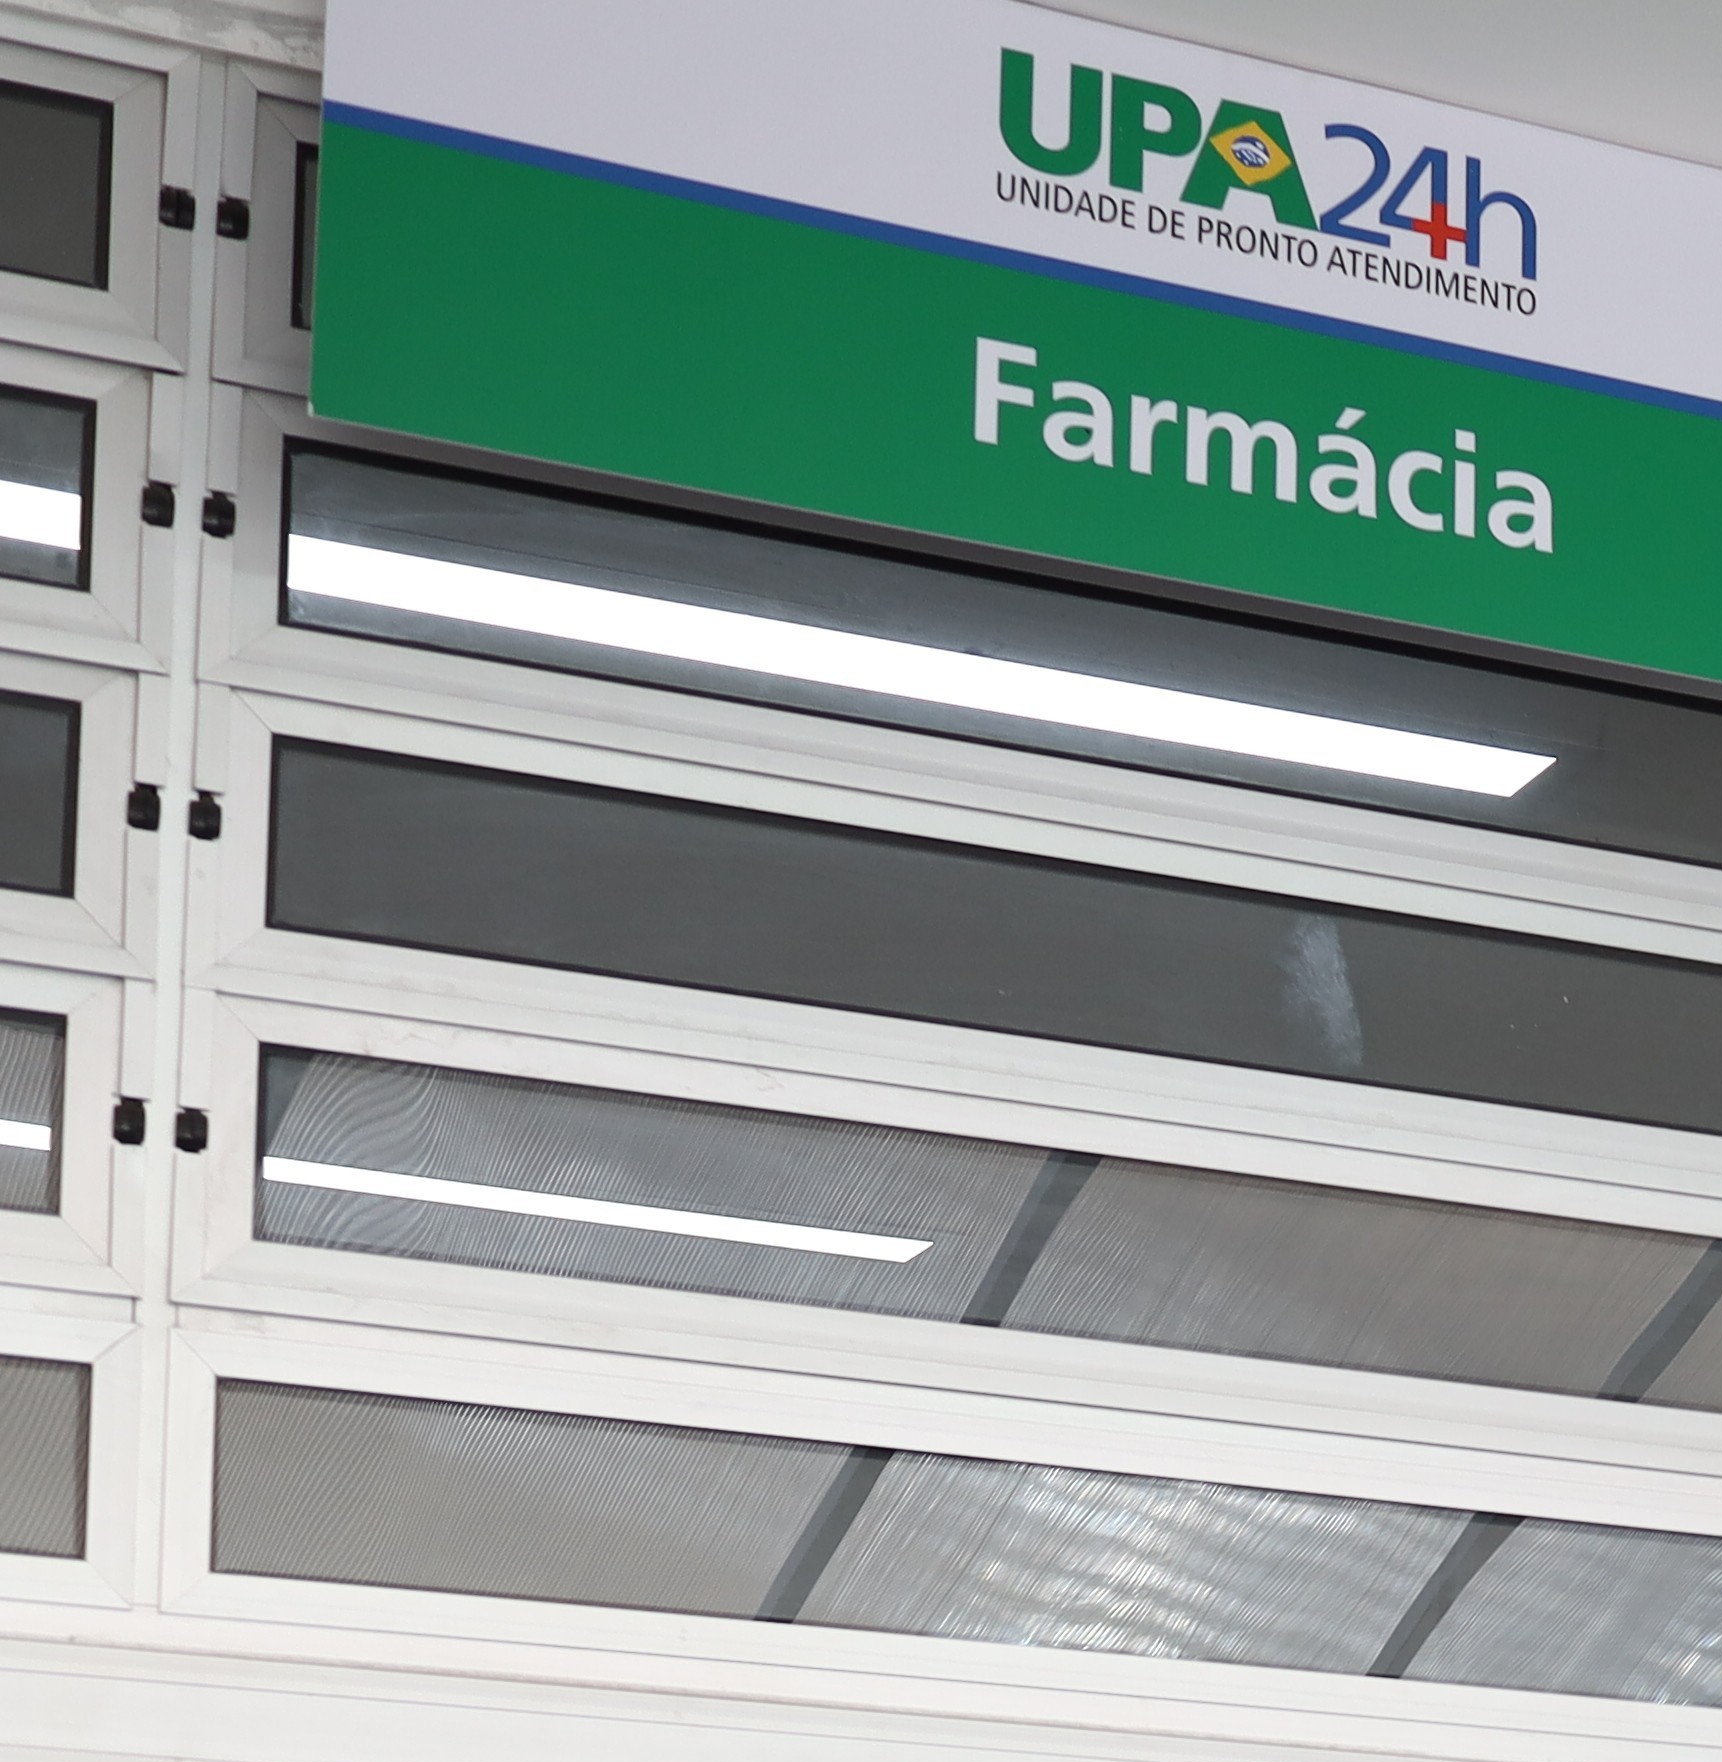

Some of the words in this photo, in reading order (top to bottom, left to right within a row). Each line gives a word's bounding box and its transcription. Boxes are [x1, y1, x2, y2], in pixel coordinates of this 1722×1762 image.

[996, 171, 1136, 229] UNIDADE
[1148, 205, 1186, 242] DE
[1198, 215, 1318, 268] PRONTO
[1326, 245, 1537, 316] ATENDIMENTO
[973, 336, 1554, 554] Farmácia
